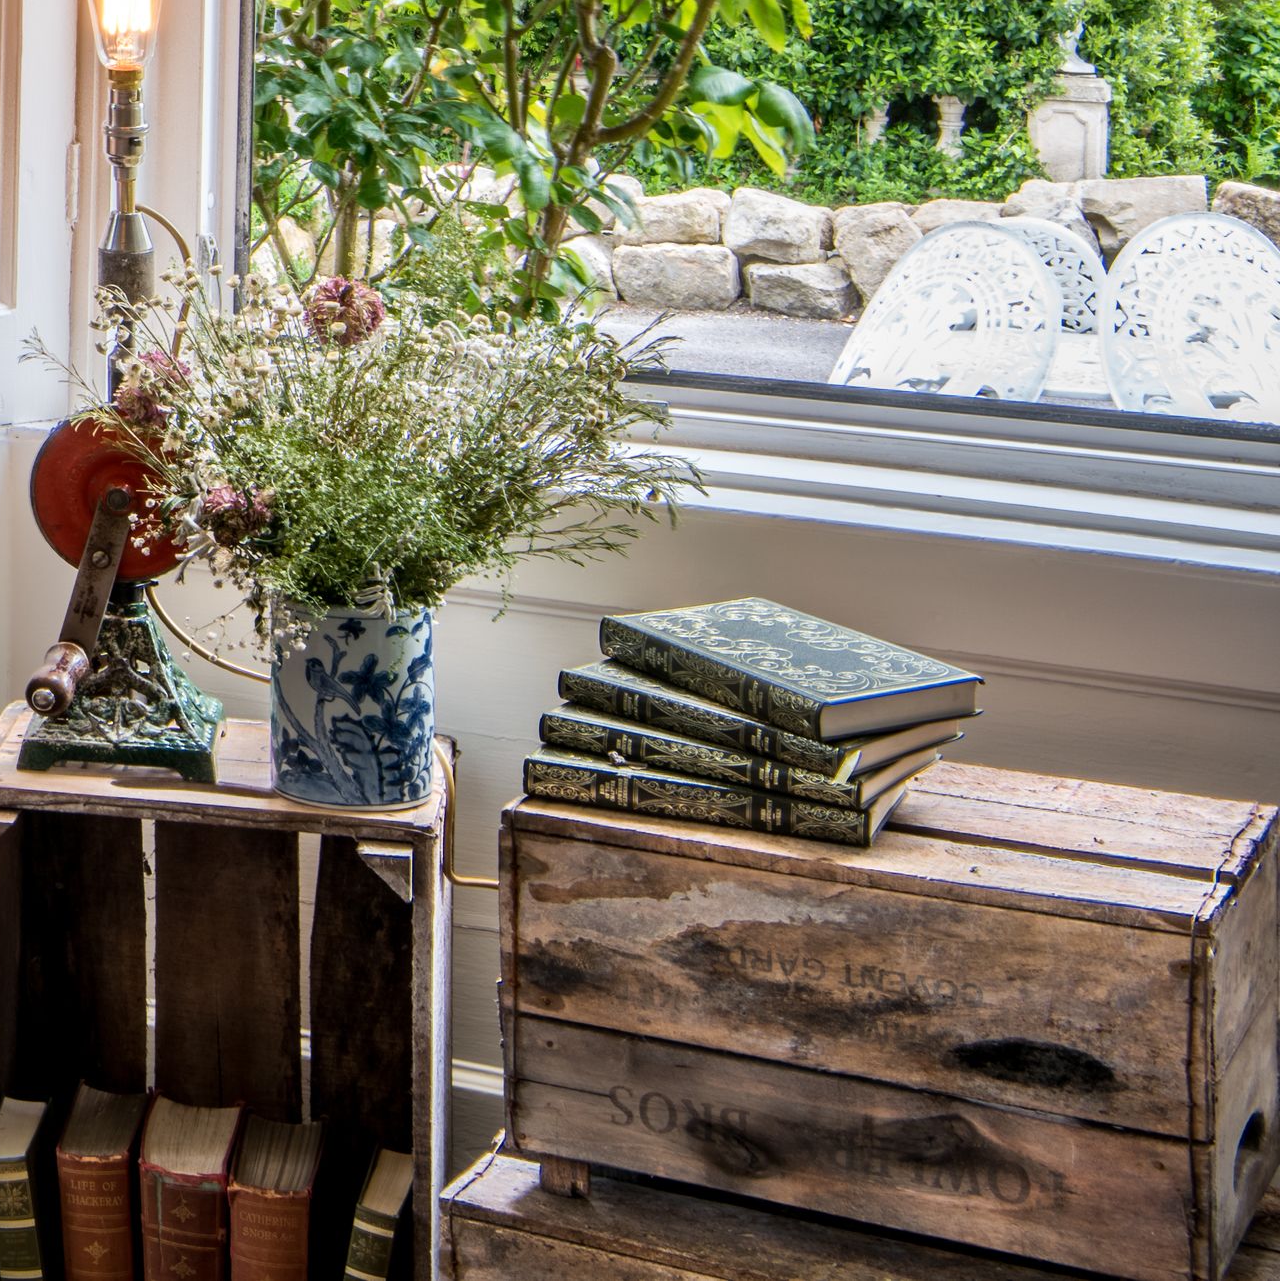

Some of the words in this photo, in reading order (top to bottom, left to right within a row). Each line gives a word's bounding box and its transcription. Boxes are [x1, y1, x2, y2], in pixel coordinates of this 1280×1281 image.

[70, 1179, 96, 1191] LIFE
[102, 1181, 117, 1191] OF
[65, 1193, 124, 1207] THACKERAY
